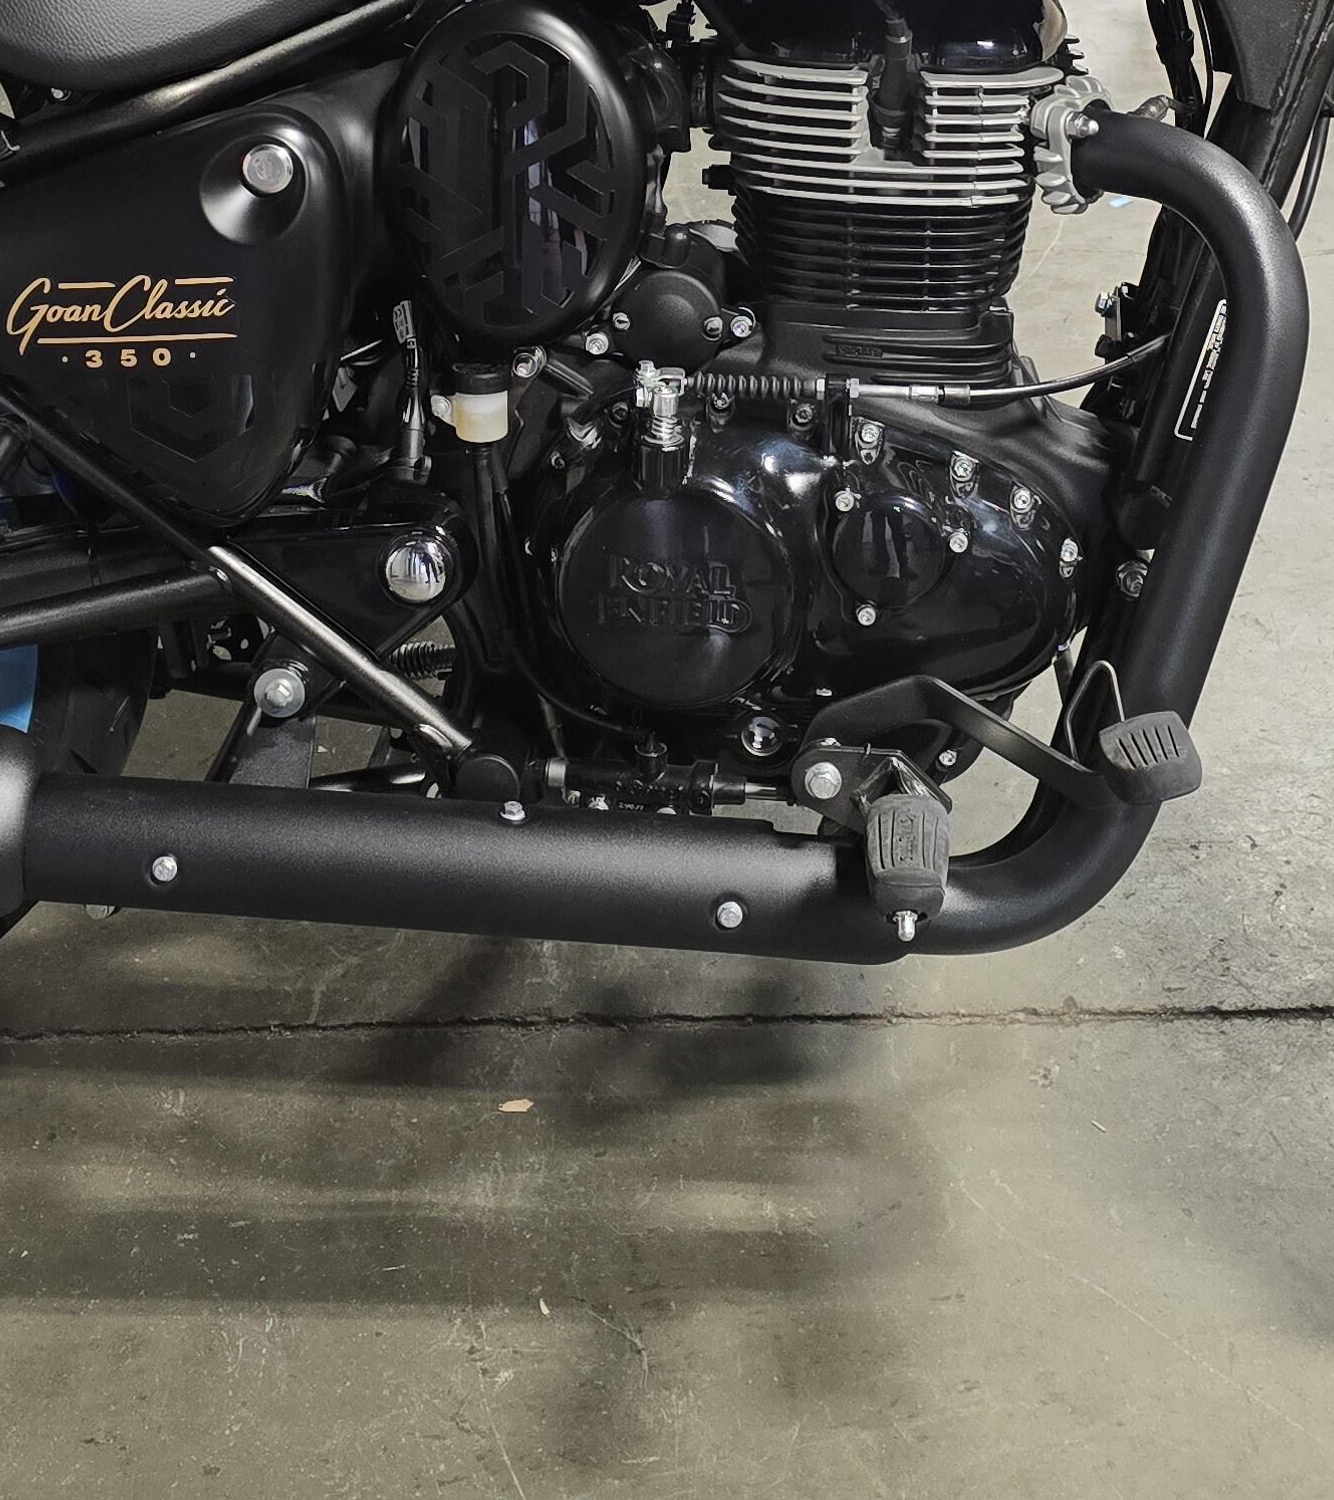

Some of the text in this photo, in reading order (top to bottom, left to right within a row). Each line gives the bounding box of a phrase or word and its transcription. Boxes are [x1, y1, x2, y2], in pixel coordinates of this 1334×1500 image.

[6, 274, 236, 356] Goan Classic
[85, 347, 172, 369] 350
